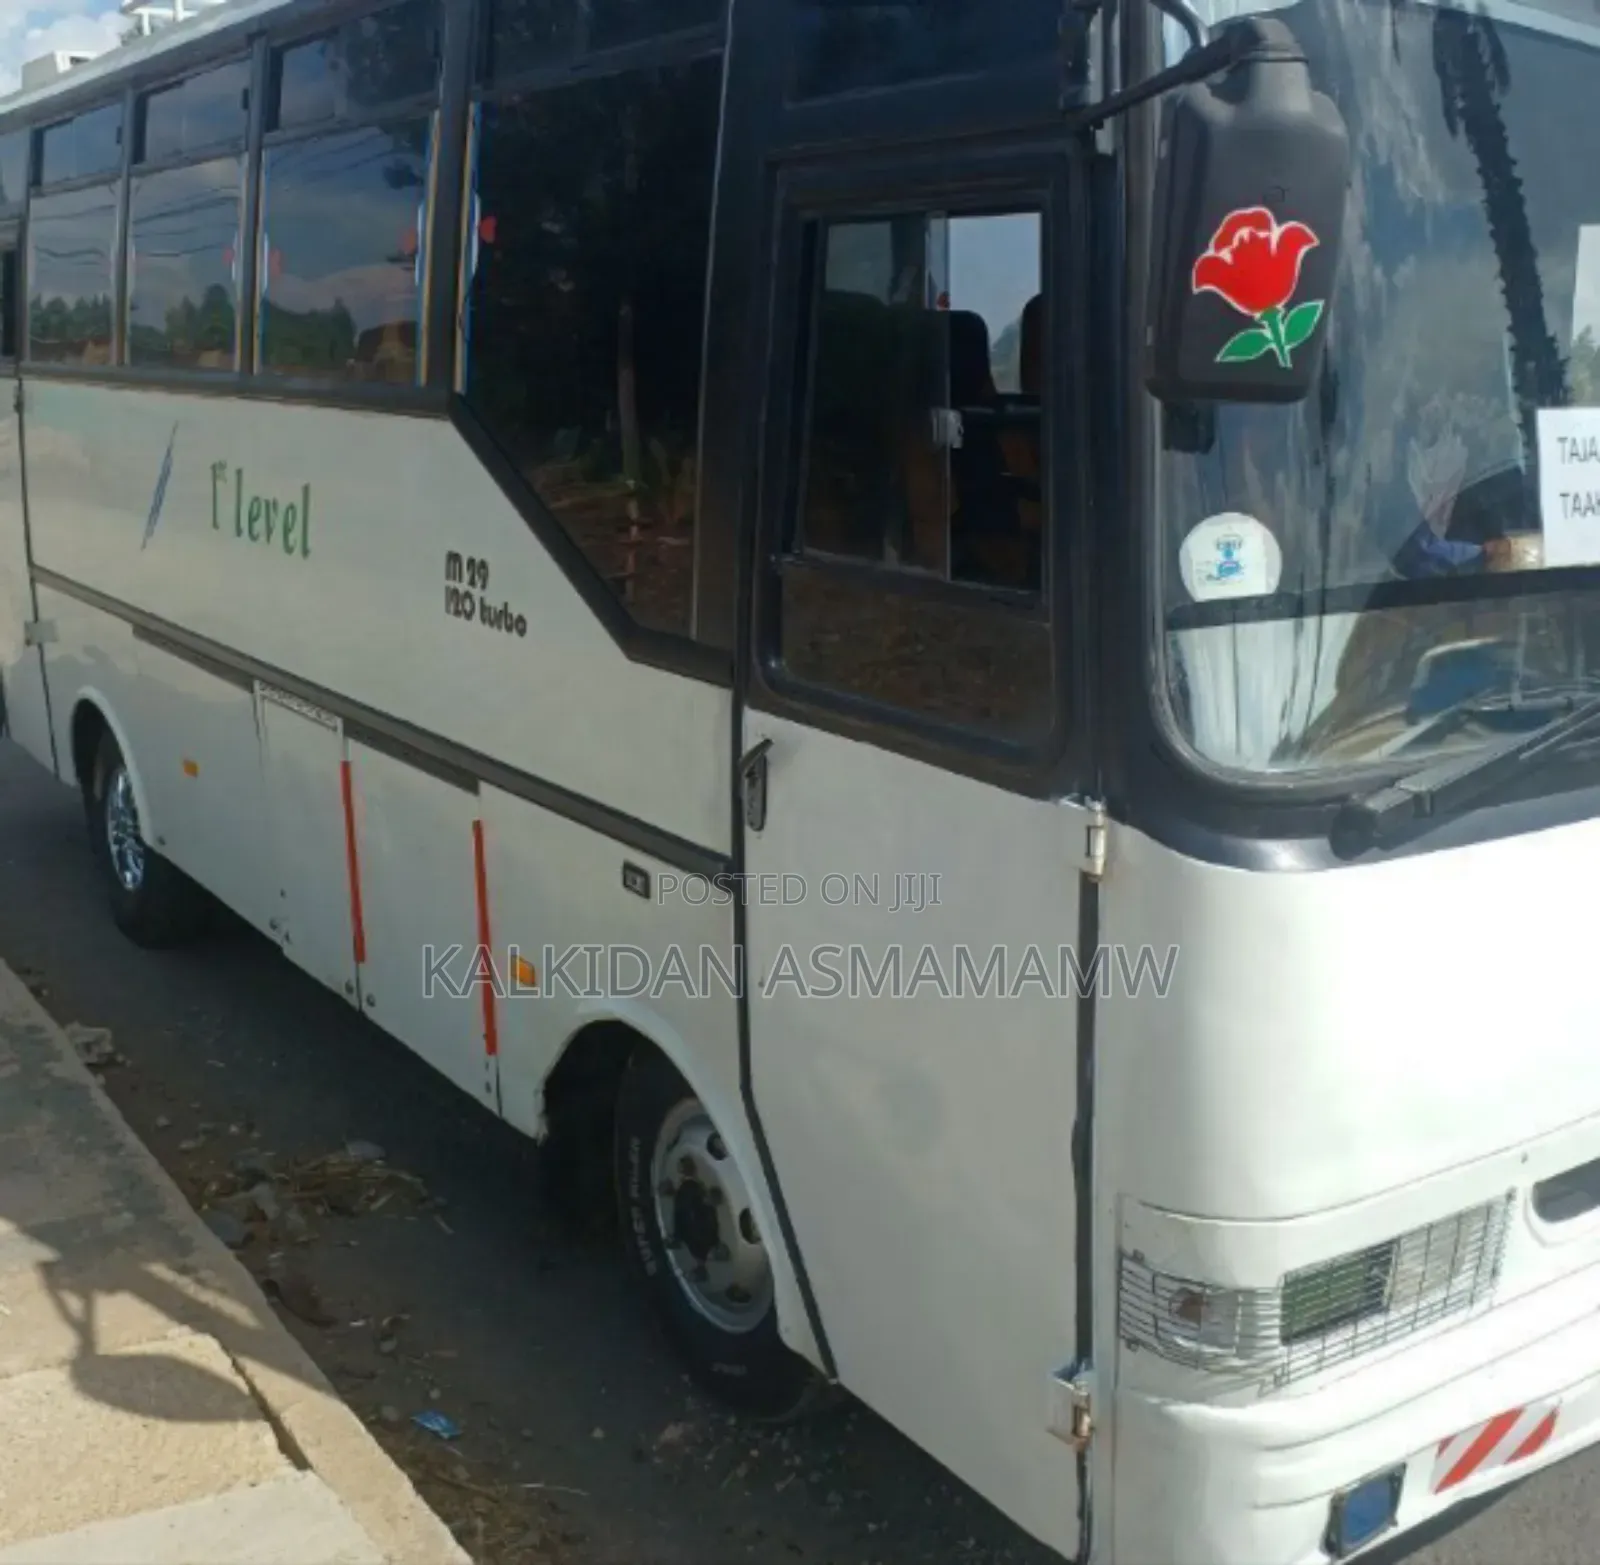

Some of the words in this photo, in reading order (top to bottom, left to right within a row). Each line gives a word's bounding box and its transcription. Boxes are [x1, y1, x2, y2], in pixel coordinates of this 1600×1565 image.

[1556, 436, 1600, 465] TAJA
[235, 467, 312, 560] level
[466, 555, 489, 592] 29
[479, 595, 527, 638] turbo
